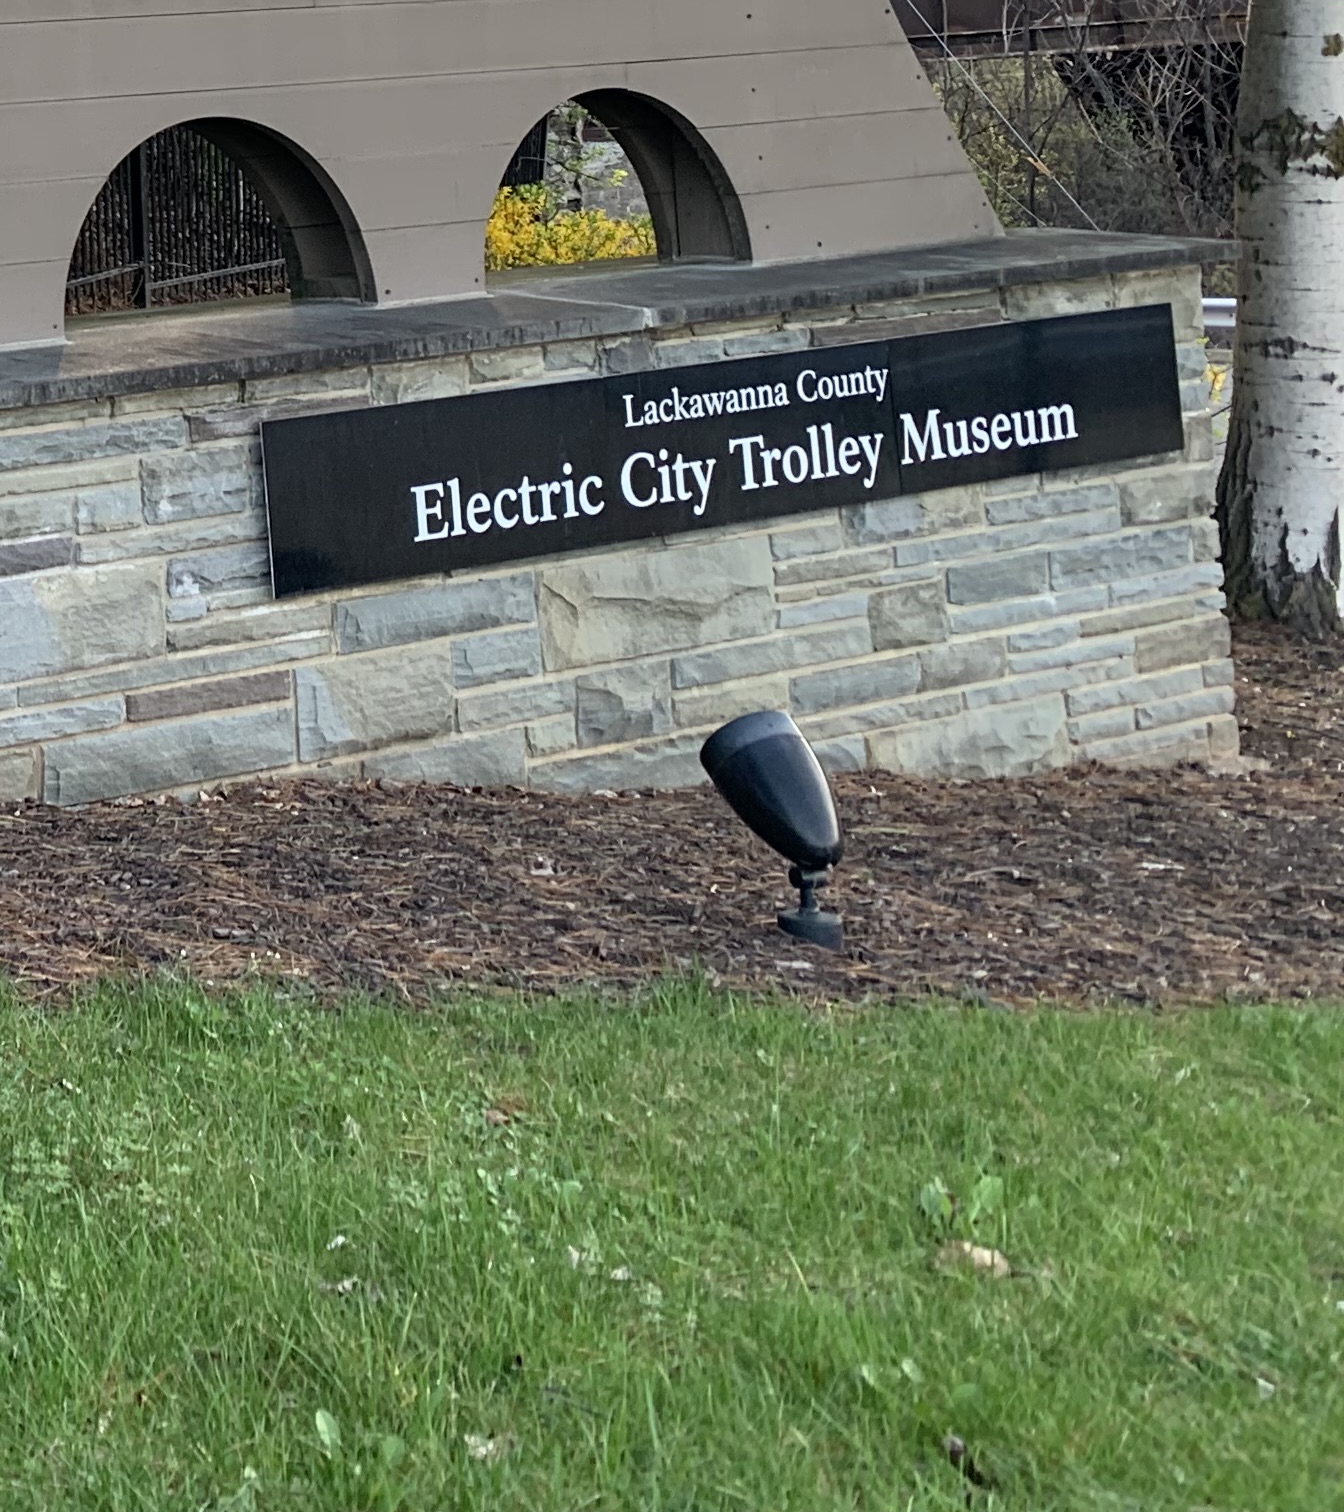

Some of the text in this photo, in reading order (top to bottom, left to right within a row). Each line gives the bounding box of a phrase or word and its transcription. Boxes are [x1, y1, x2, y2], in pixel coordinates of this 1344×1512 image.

[623, 366, 888, 427] Lackawanna County
[411, 404, 1078, 542] Electric City Trolley Museum
